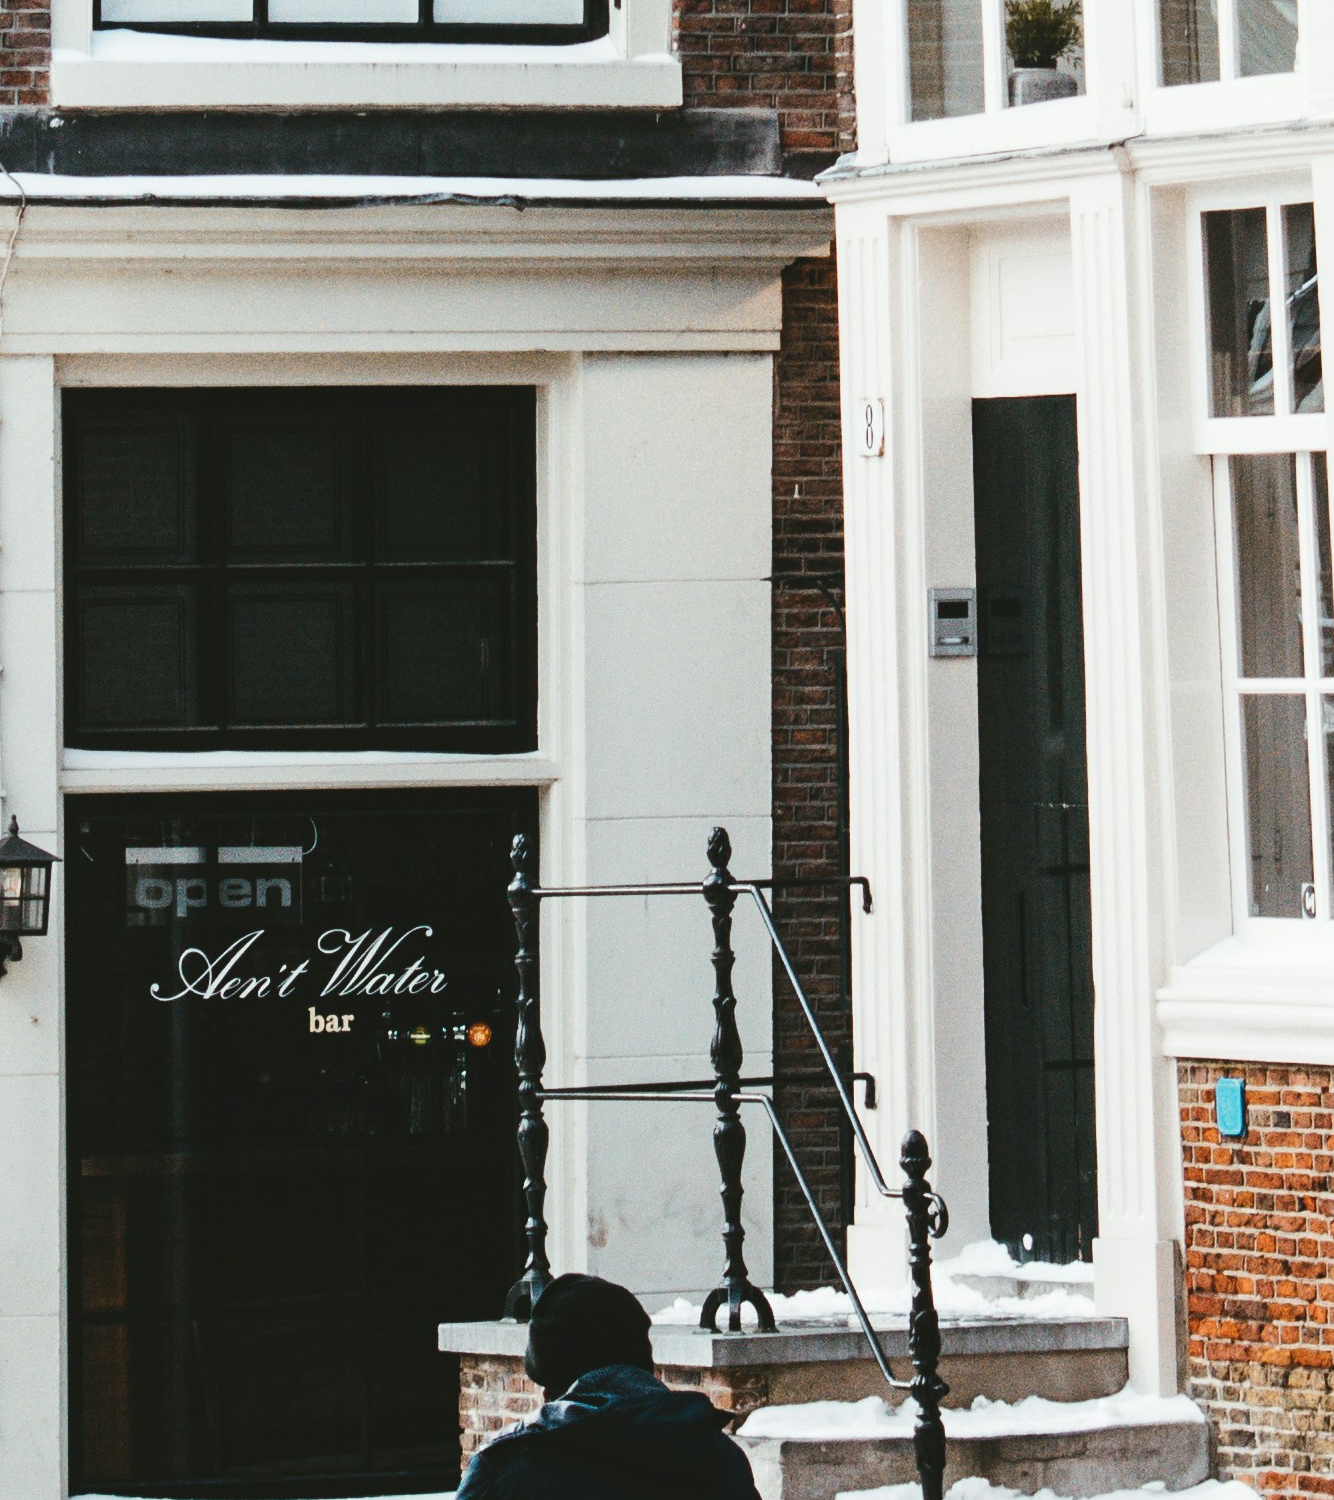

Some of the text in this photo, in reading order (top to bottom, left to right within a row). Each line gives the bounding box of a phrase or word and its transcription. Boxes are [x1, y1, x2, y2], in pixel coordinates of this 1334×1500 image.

[865, 403, 874, 450] 8
[135, 874, 293, 918] open
[149, 925, 449, 1002] Aen't Water
[307, 1007, 355, 1035] bar
